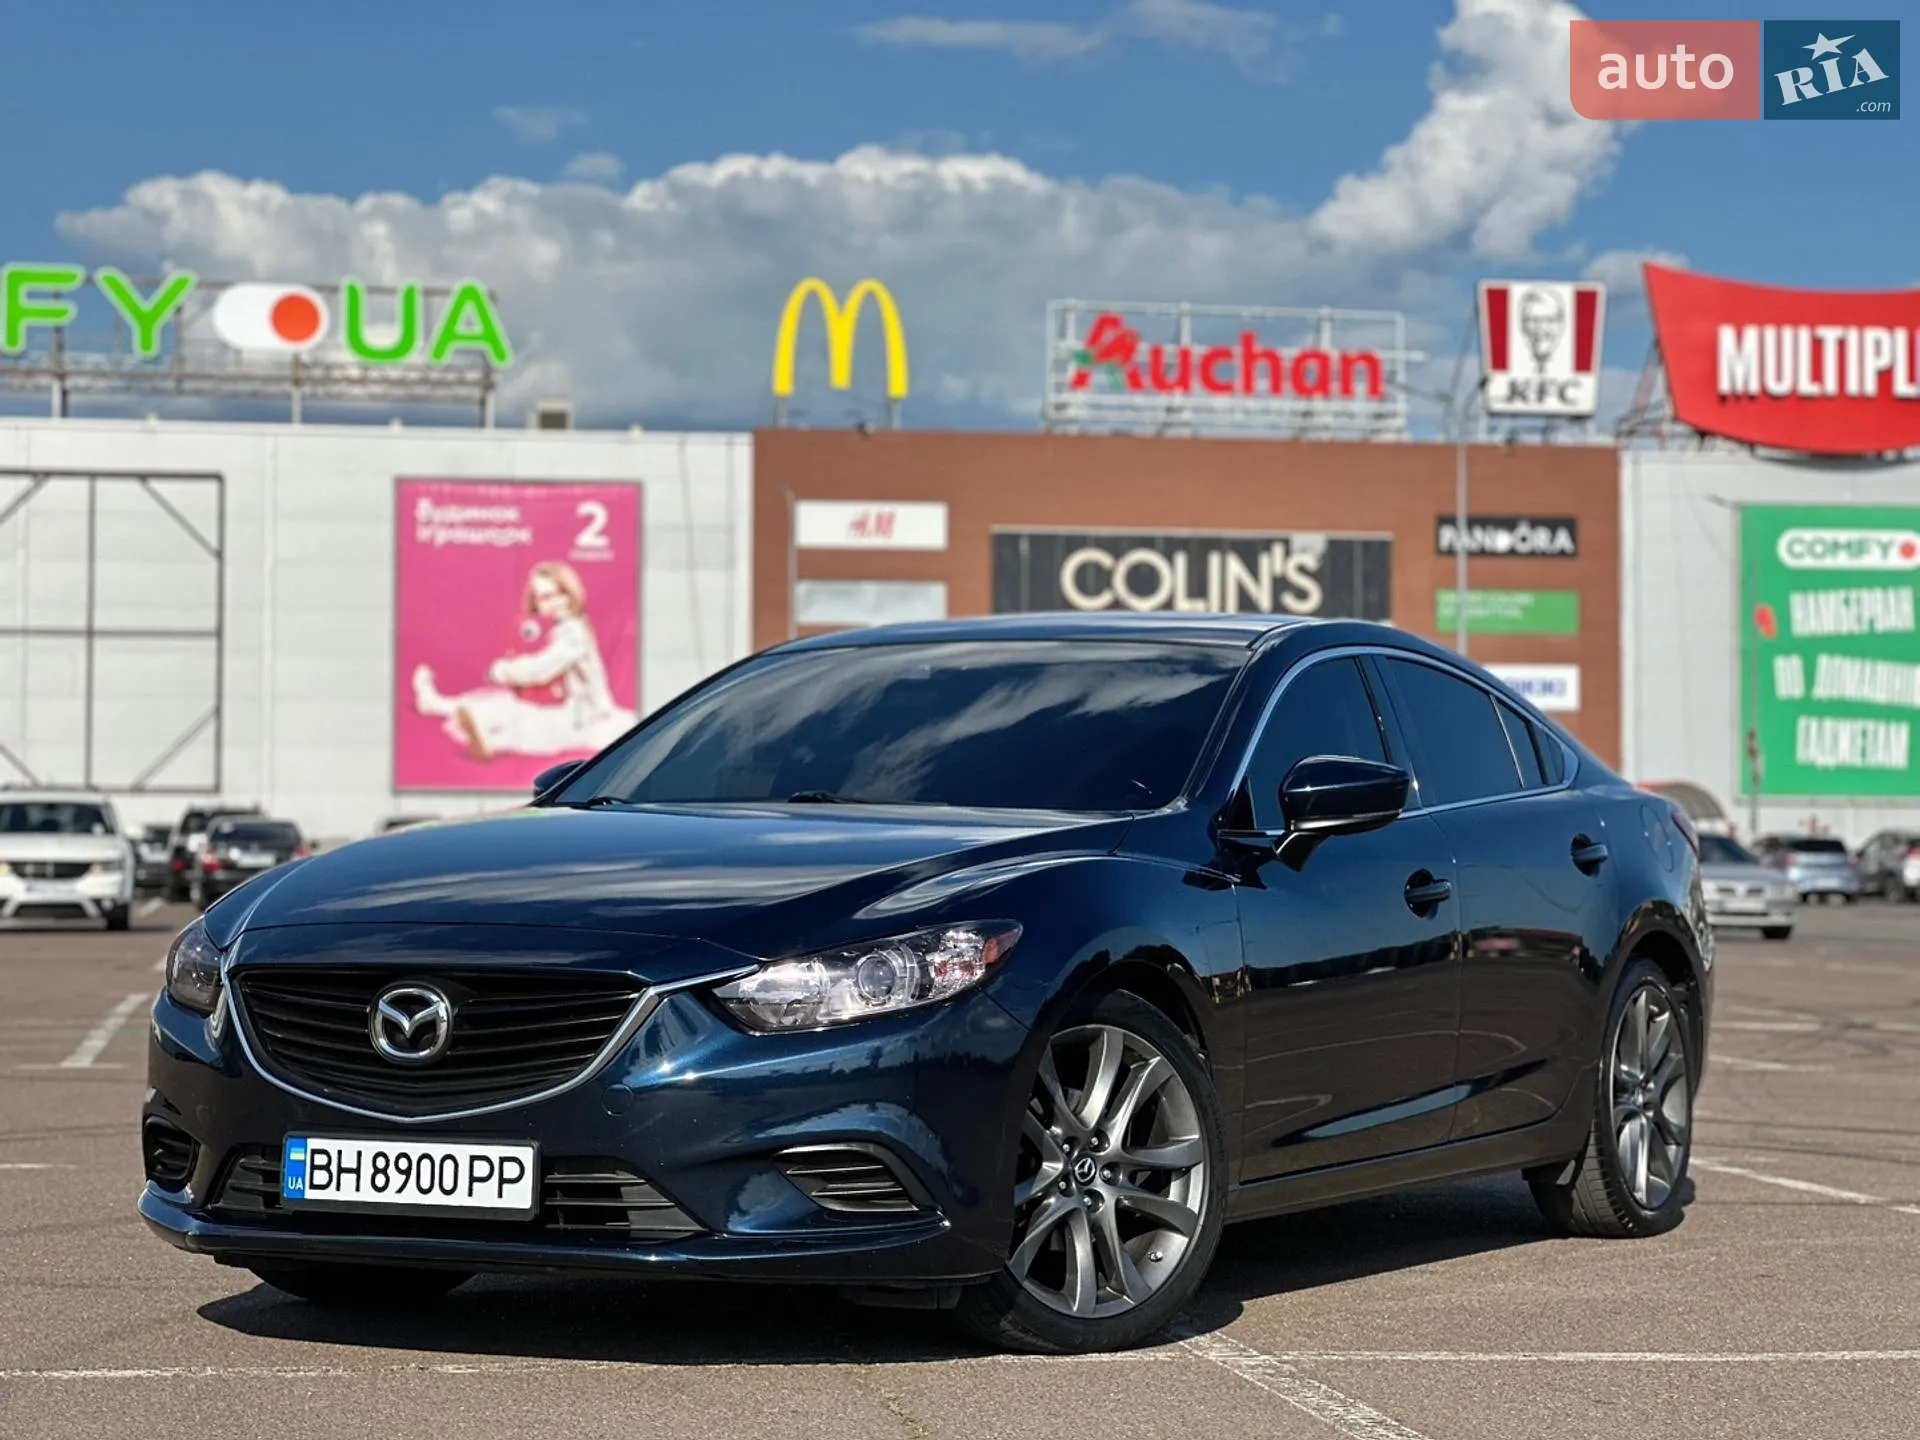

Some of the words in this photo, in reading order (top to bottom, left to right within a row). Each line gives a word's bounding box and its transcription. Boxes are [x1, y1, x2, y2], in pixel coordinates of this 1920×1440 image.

[1, 263, 197, 359] FY
[341, 277, 512, 369] UA
[1070, 312, 1385, 399] Auchan
[1717, 324, 1920, 397] MULTIPL
[1506, 379, 1582, 405] KFC
[576, 500, 610, 548] 2
[1786, 539, 1893, 561] COMFY
[1060, 543, 1323, 613] COLIN'S
[287, 1177, 304, 1191] UA
[308, 1147, 362, 1192] BH
[370, 1151, 460, 1196] 8900
[466, 1154, 527, 1199] PP
